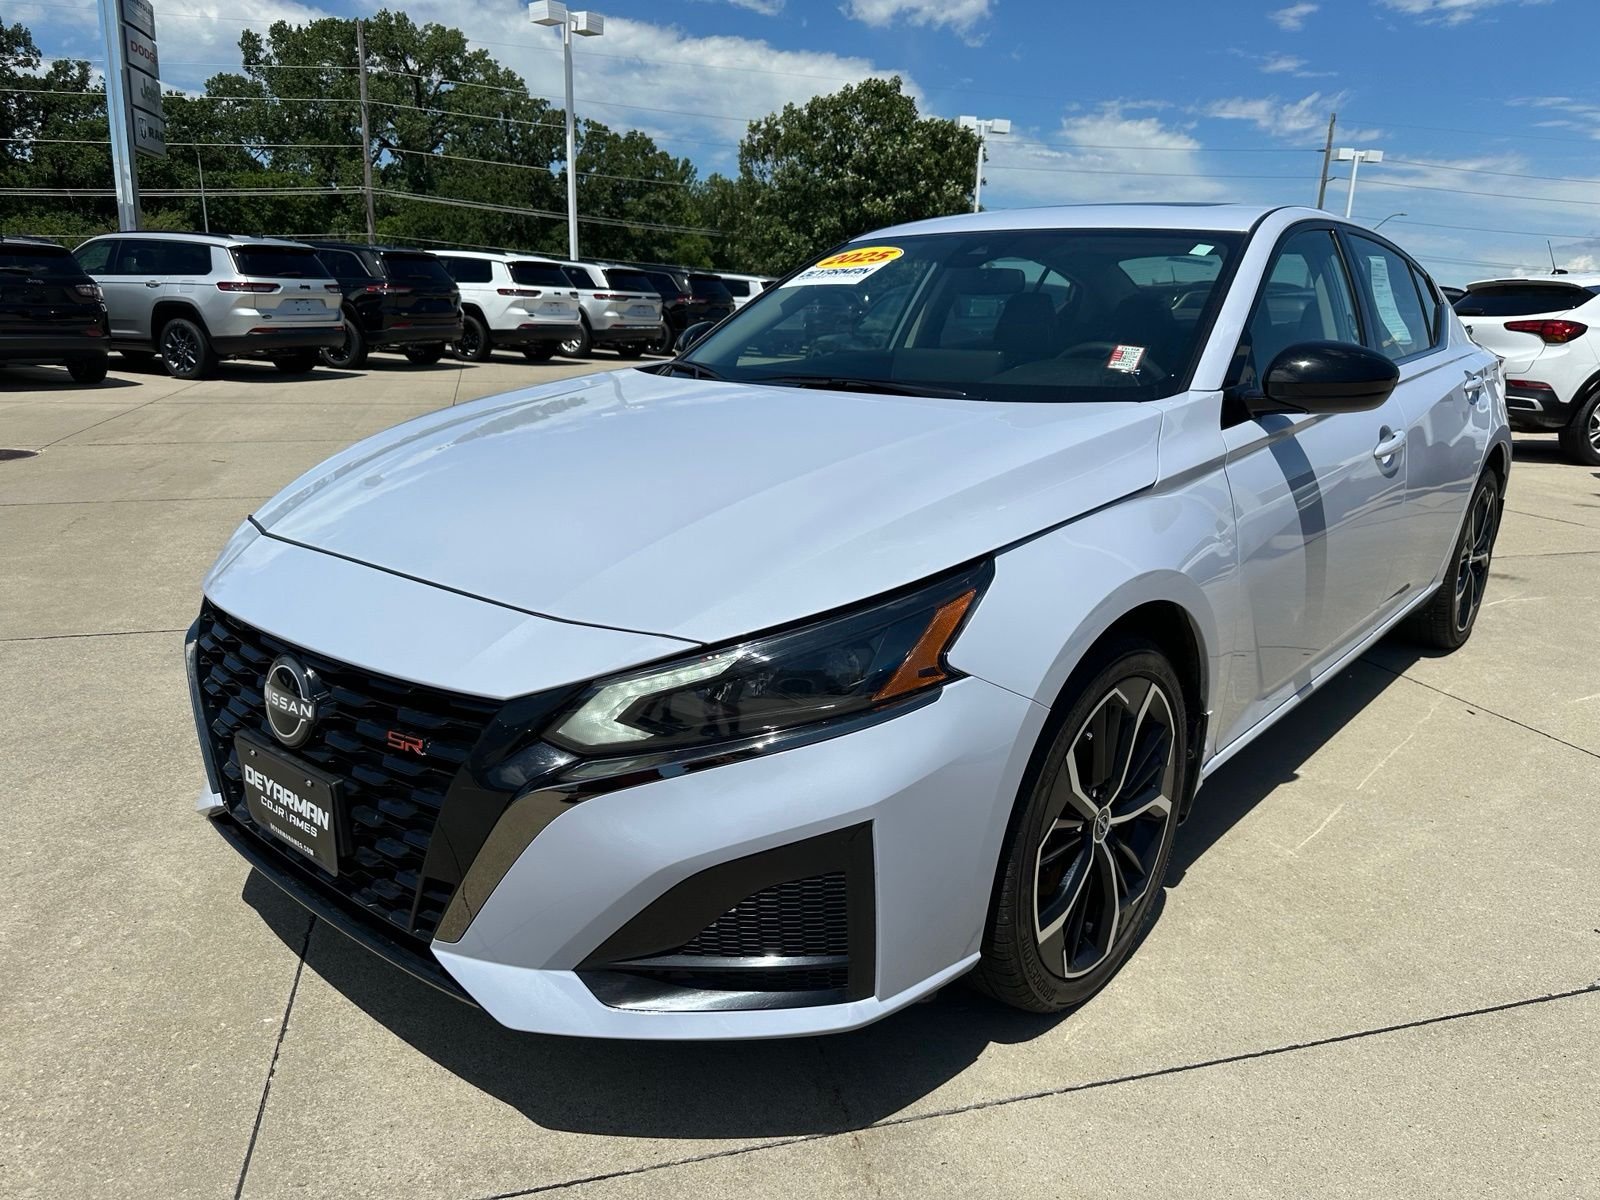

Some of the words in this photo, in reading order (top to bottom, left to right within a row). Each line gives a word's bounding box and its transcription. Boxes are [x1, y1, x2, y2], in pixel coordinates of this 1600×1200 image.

[821, 251, 897, 266] 2025
[265, 685, 313, 718] NISSAN
[387, 730, 427, 756] SR
[244, 764, 329, 831] DEYARMAN
